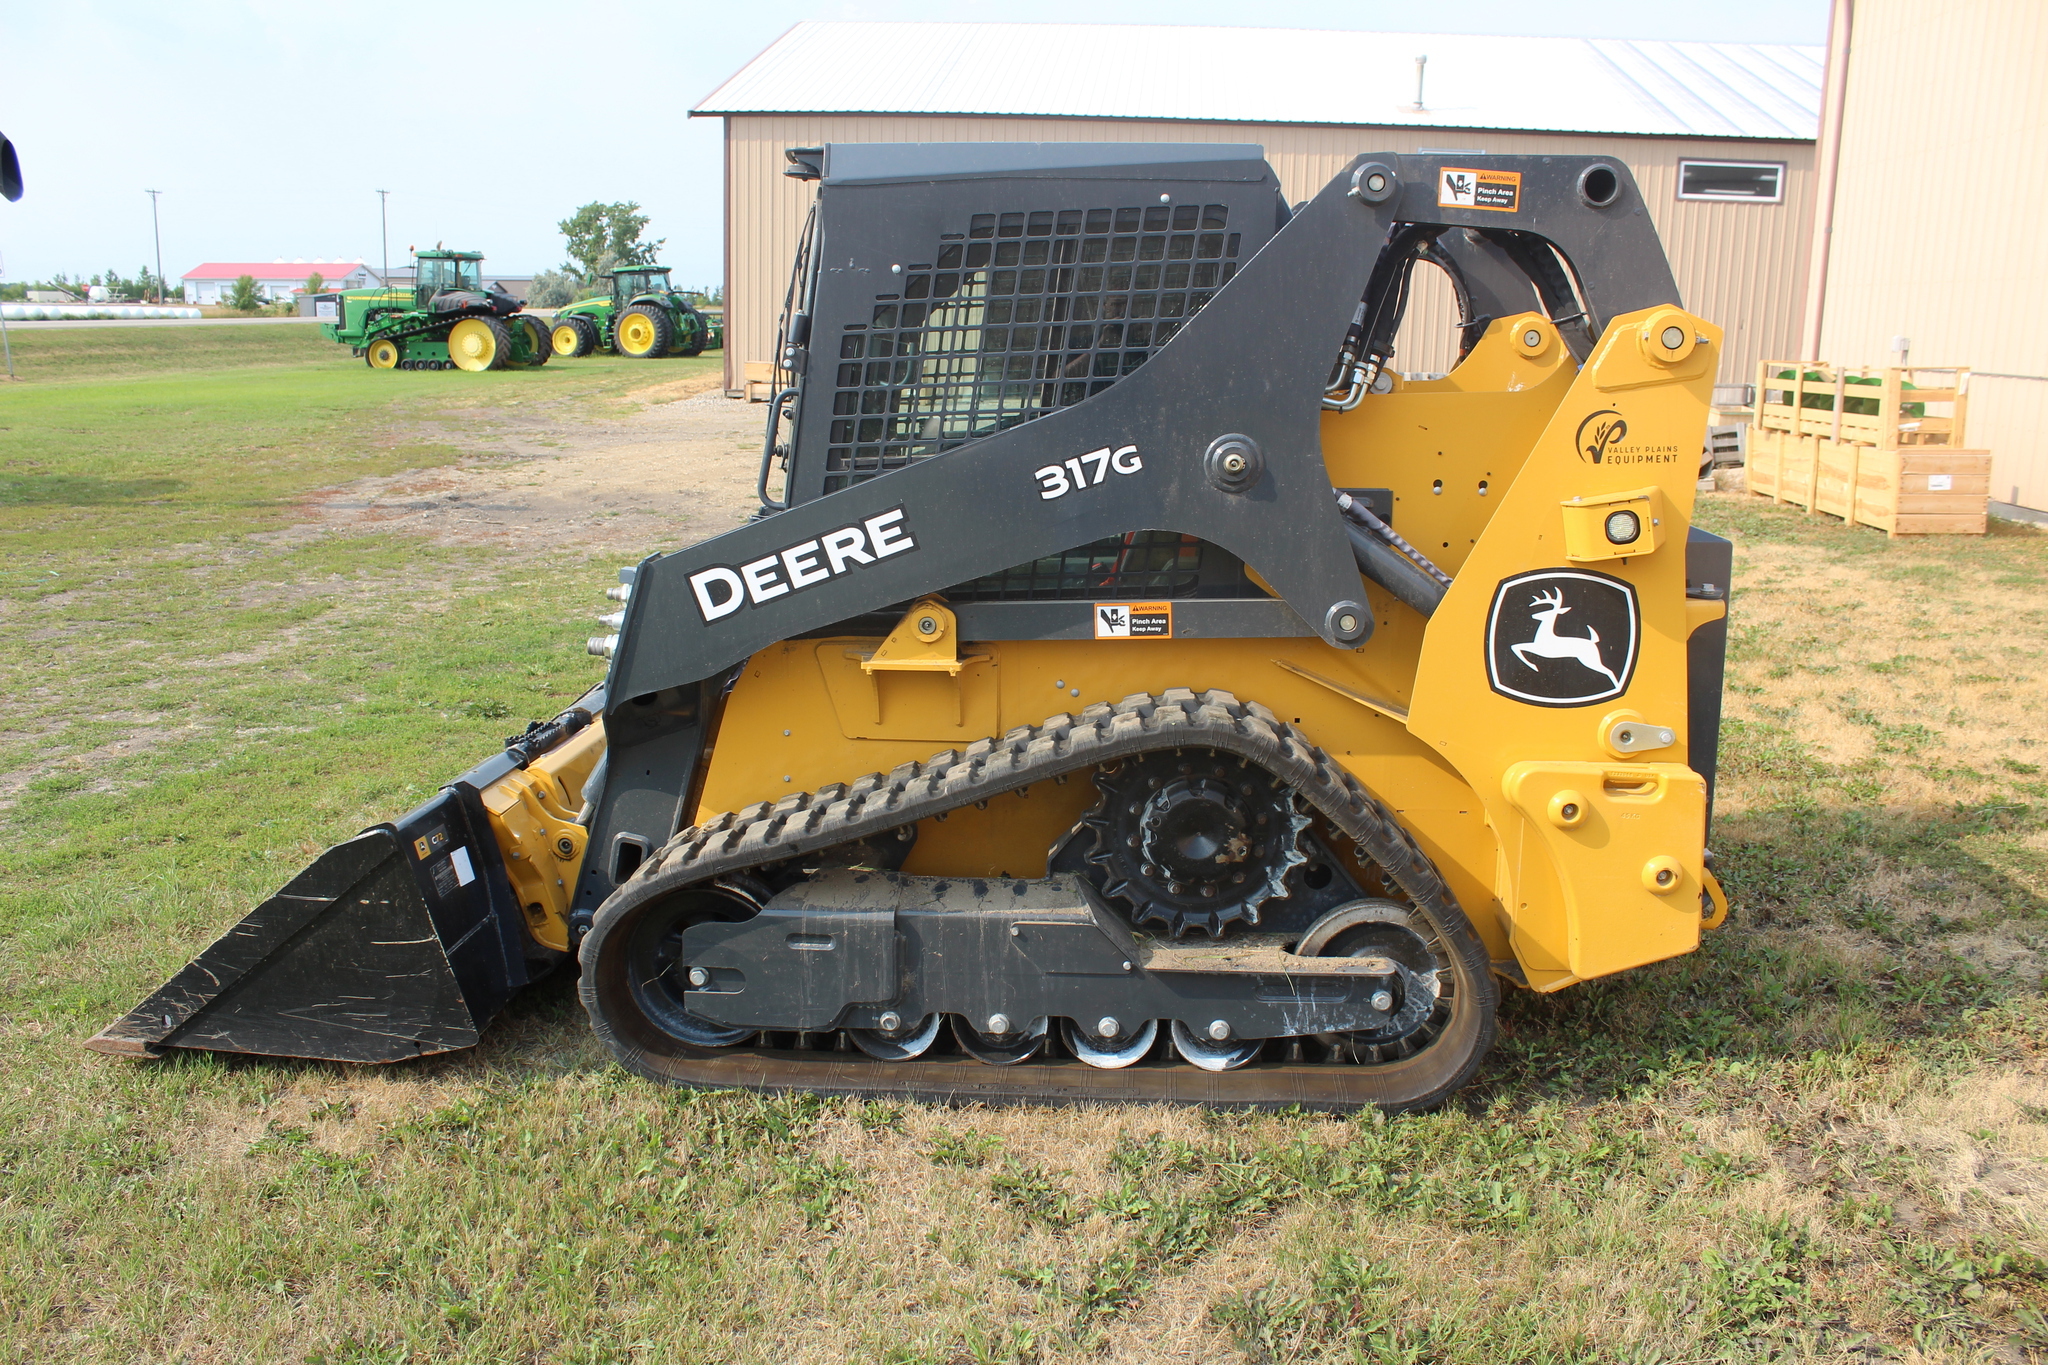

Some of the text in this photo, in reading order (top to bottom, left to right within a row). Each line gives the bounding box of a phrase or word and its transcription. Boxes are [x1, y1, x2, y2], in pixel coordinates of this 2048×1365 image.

[1486, 174, 1517, 182] WARNING
[1477, 187, 1514, 197] Pinch Area
[1492, 196, 1508, 204] Away
[1607, 445, 1678, 454] VALLEY PLAINS
[1607, 454, 1678, 465] EQUIPMENT
[1034, 444, 1143, 500] 317G
[689, 508, 914, 622] DEERE
[431, 832, 444, 845] C72
